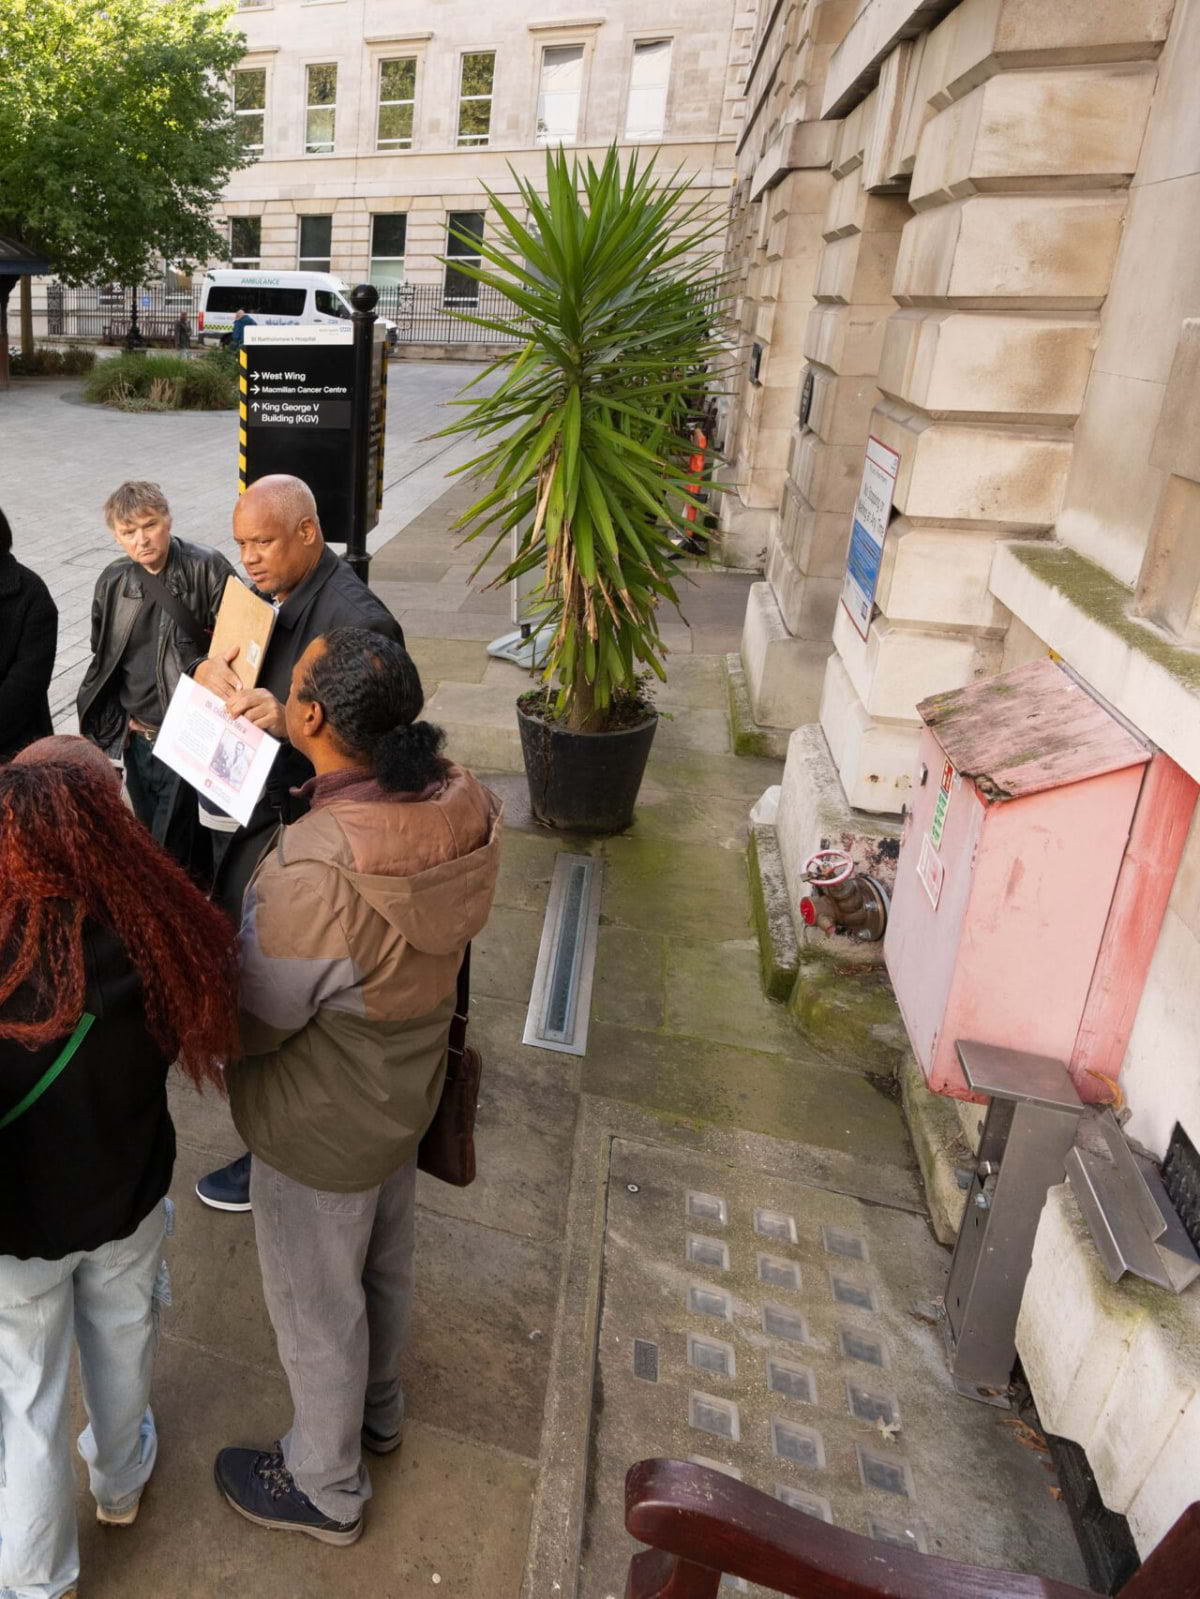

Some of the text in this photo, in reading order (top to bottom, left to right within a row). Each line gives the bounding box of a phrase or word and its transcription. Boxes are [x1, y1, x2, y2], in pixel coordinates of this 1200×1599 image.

[261, 372, 306, 382] West Wing
[262, 386, 347, 394] Macmillan Cancer Centre
[262, 402, 320, 413] King George V
[262, 413, 319, 424] Building (KGV)
